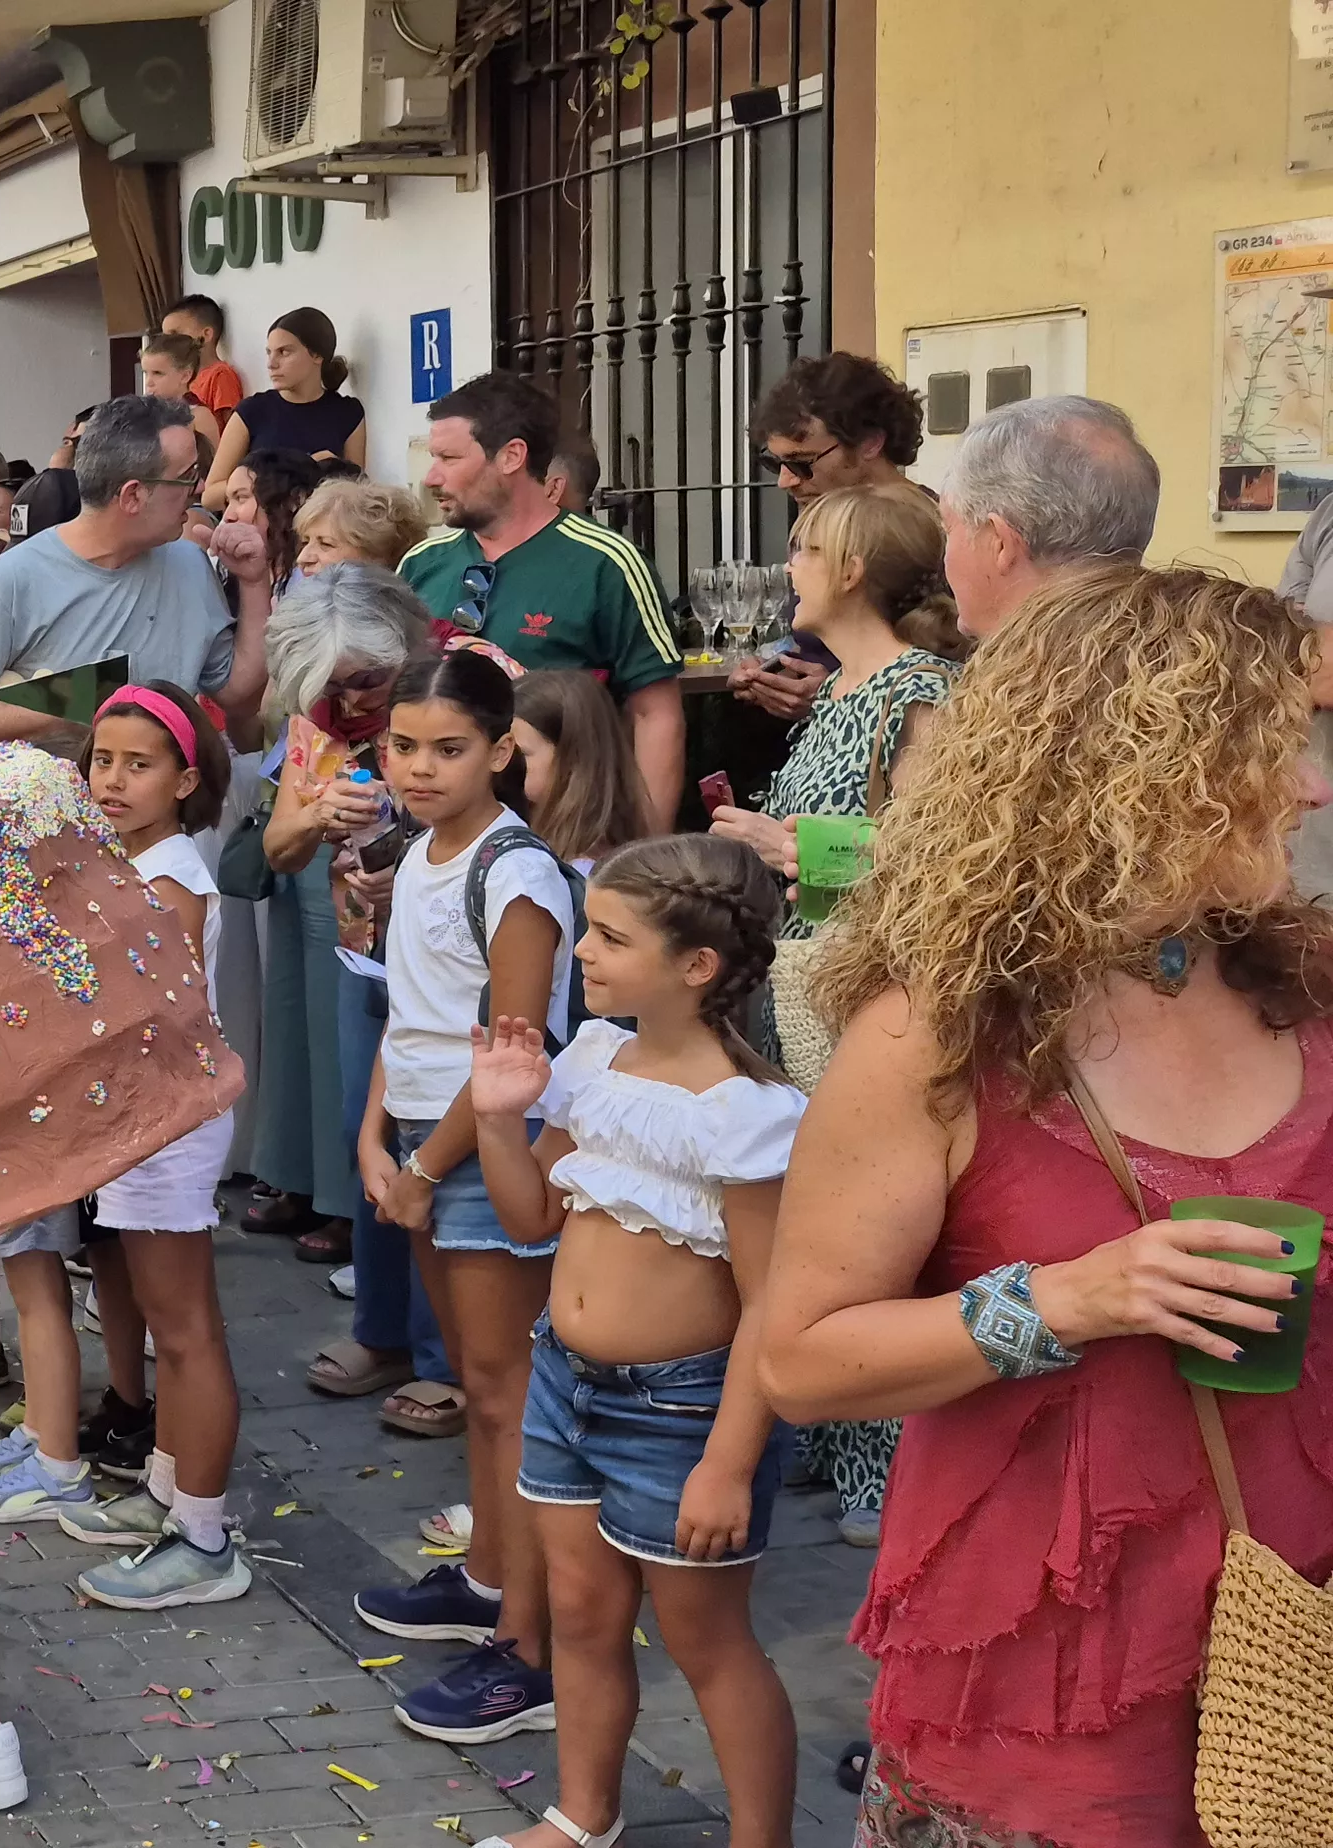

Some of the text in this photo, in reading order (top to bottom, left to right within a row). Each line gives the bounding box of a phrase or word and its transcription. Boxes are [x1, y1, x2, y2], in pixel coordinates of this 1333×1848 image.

[1232, 238, 1248, 251] GR
[1250, 235, 1274, 249] 234
[421, 320, 442, 371] R
